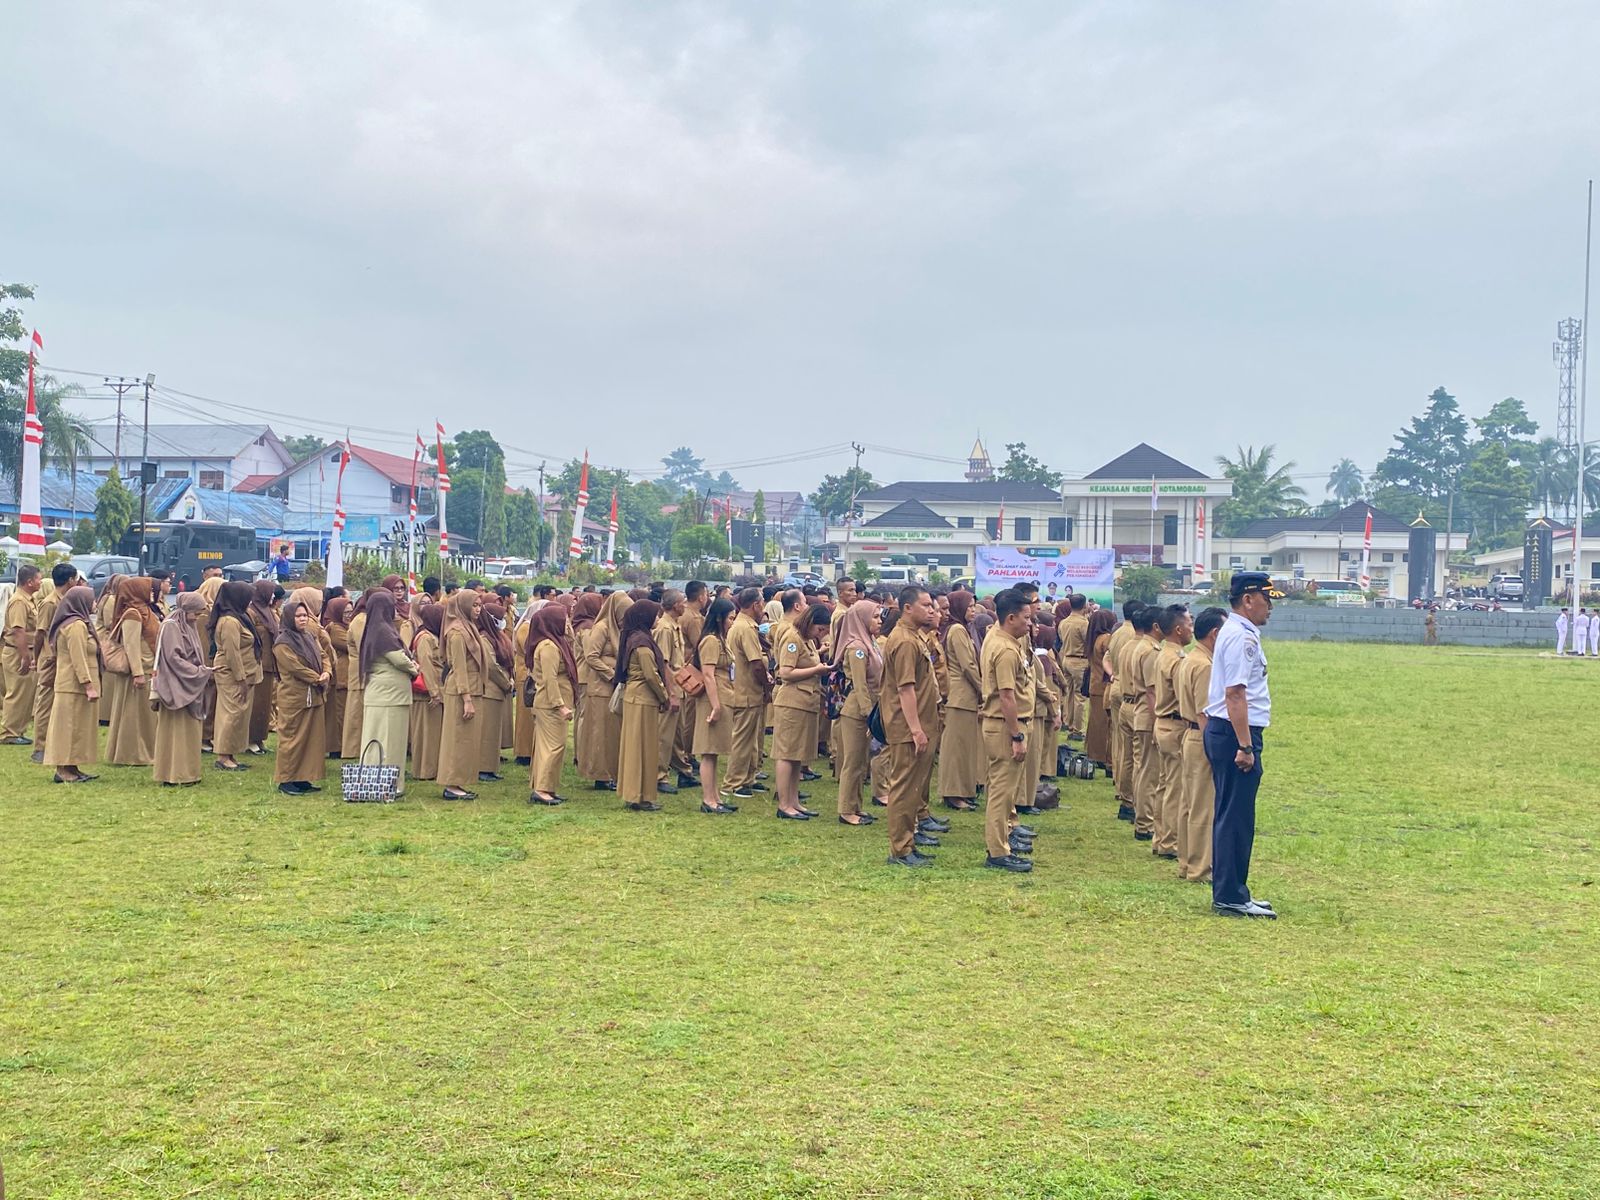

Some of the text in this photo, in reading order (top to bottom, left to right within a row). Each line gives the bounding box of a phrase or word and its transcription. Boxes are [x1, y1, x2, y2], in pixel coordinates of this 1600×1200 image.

[1089, 485, 1207, 493] KEJAKSAAN NEGER KOTAMOBAGU
[197, 552, 223, 560] BRIMOB
[987, 569, 1039, 577] PAHLAWAN
